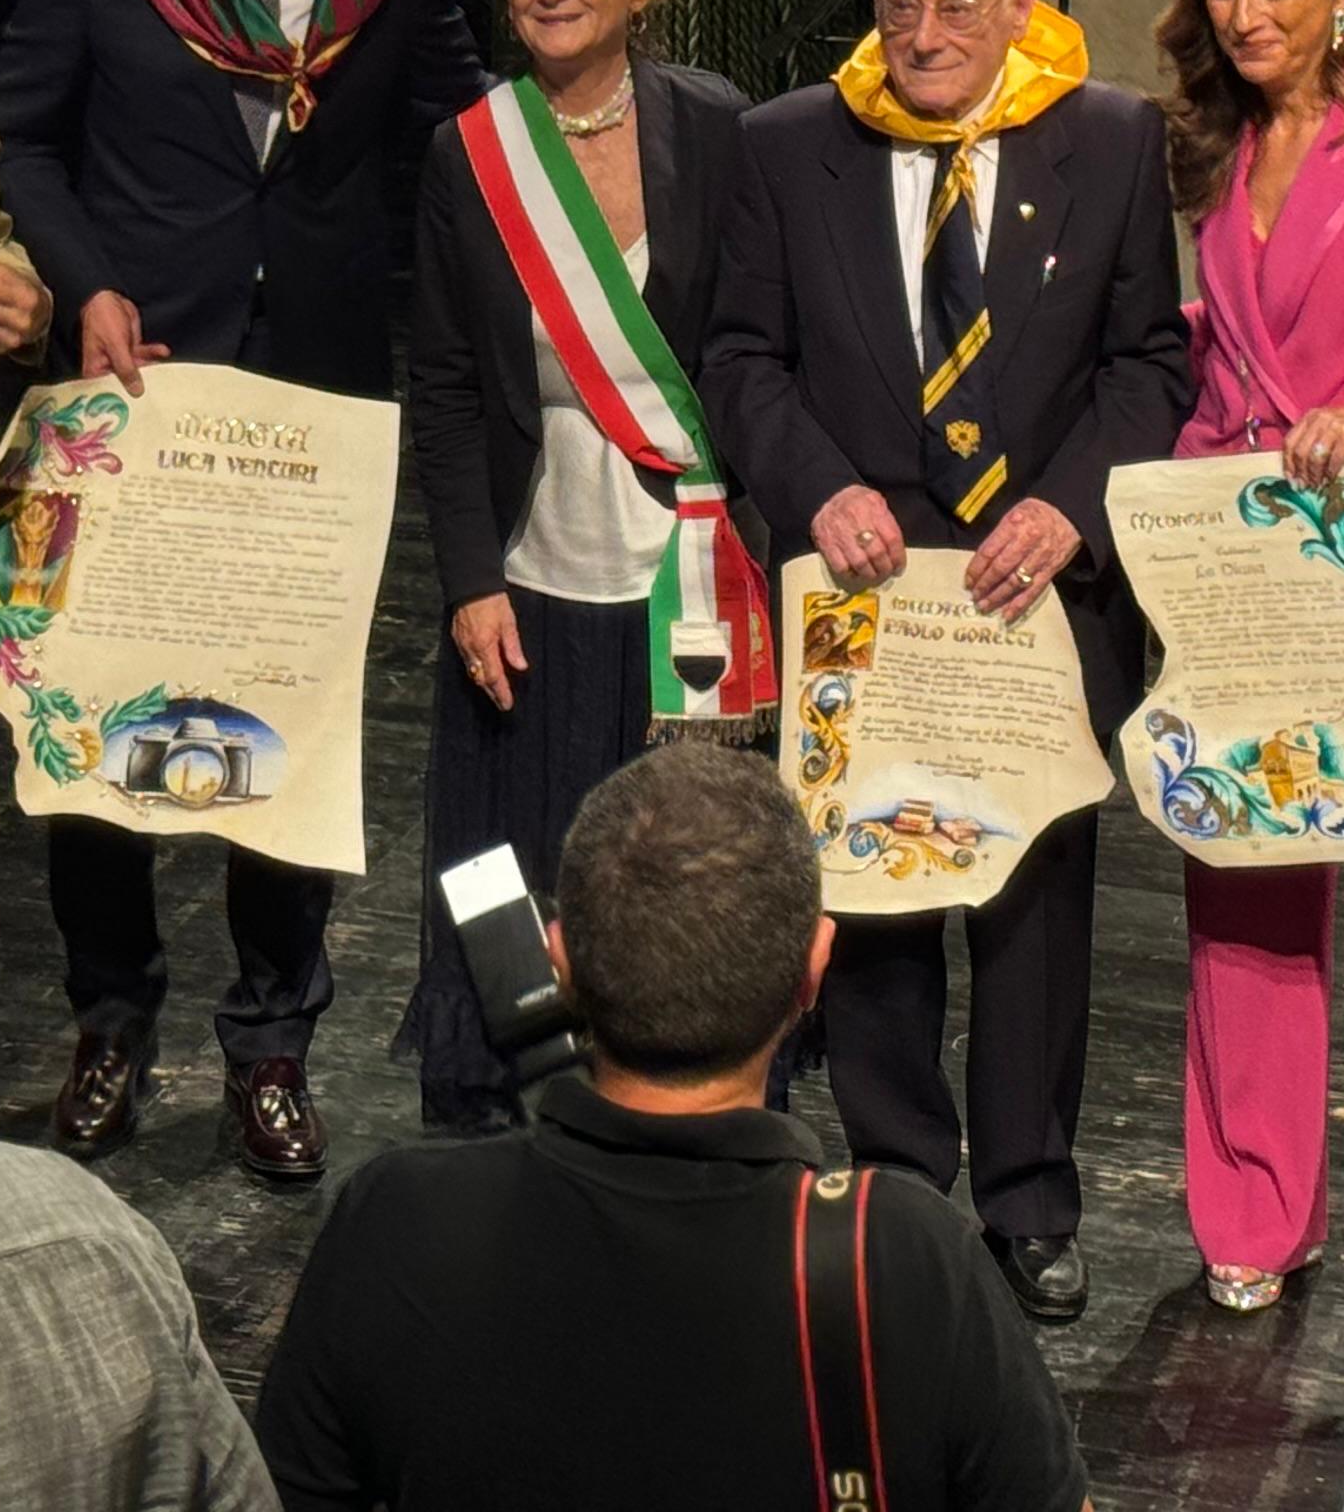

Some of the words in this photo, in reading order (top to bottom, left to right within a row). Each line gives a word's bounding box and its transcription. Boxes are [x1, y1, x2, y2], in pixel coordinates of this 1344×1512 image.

[157, 449, 216, 474] LUCA
[227, 456, 320, 485] VENTURI
[883, 618, 946, 642] PAOLO
[952, 625, 1037, 650] GORETTI
